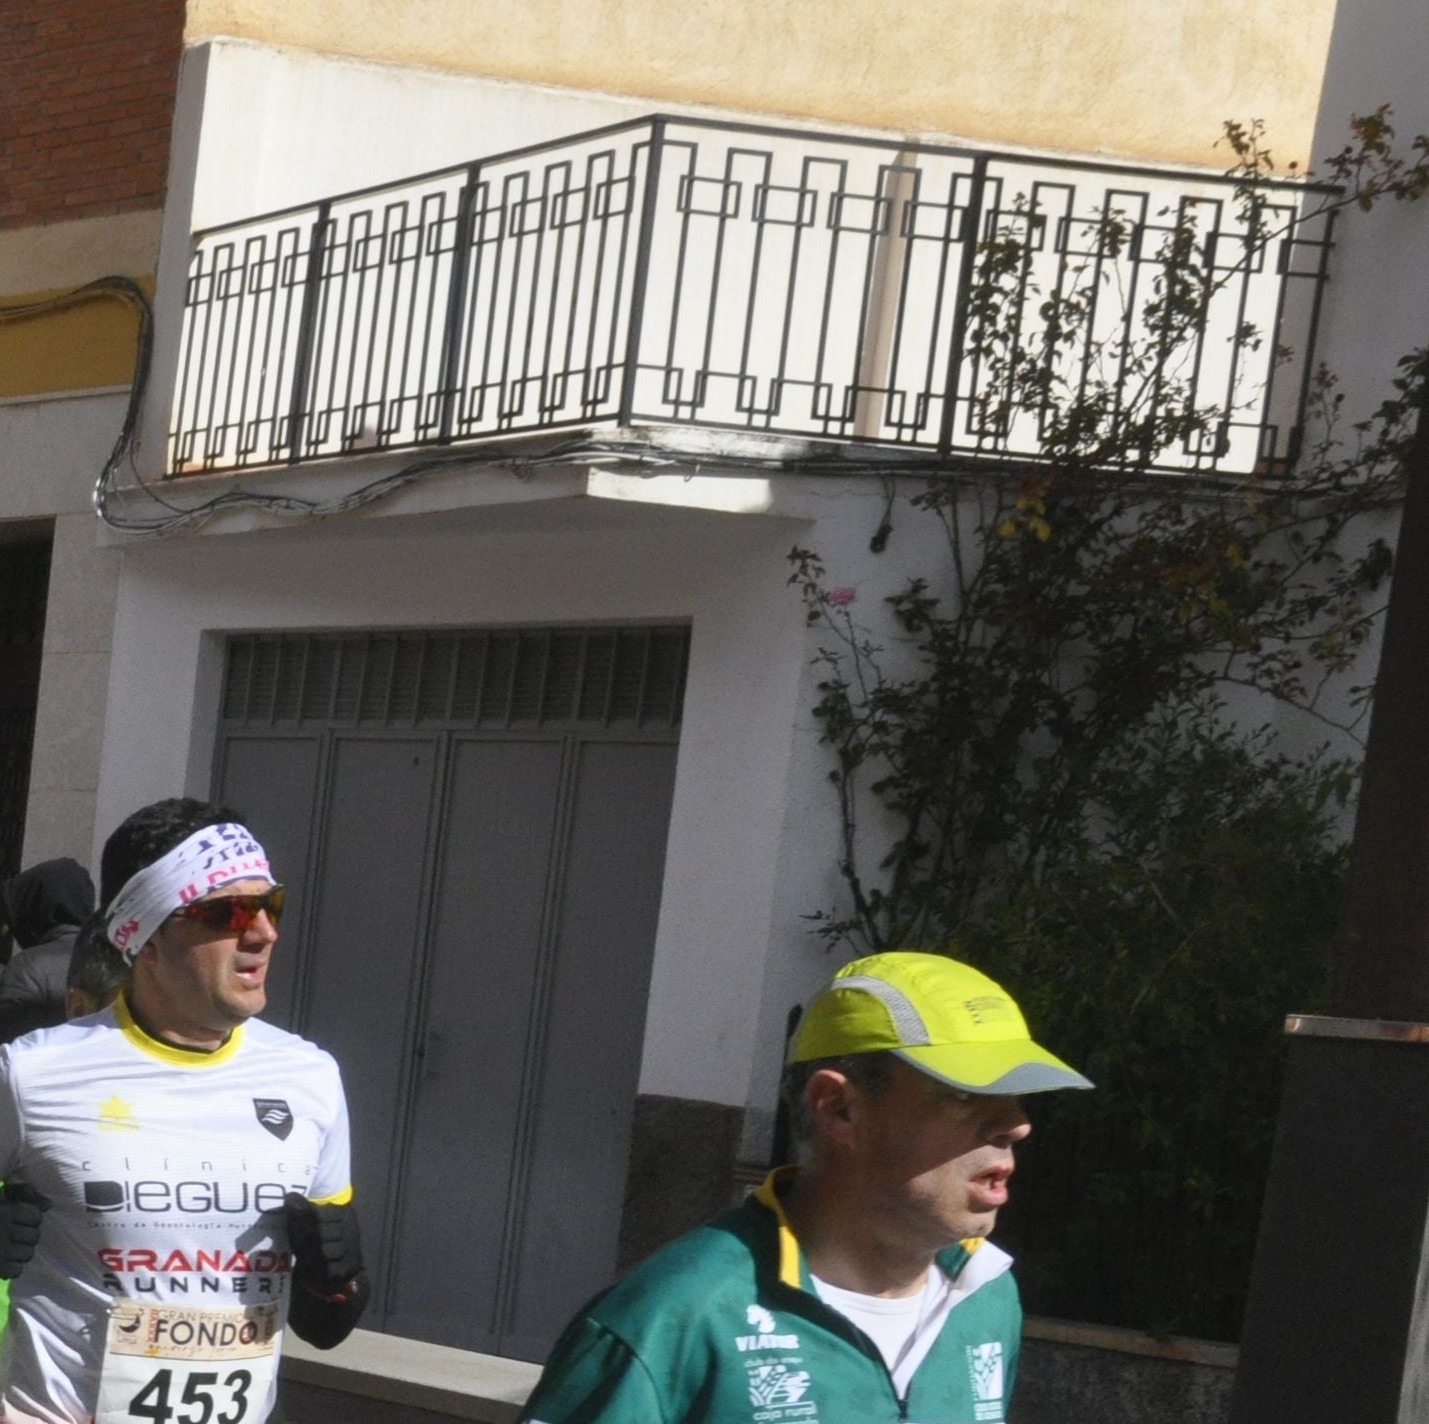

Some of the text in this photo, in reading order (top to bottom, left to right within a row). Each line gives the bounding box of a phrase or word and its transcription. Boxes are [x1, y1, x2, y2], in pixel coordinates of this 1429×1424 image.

[158, 1308, 196, 1322] GRAN
[154, 1319, 258, 1346] FONDO
[753, 1401, 817, 1422] caja rural
